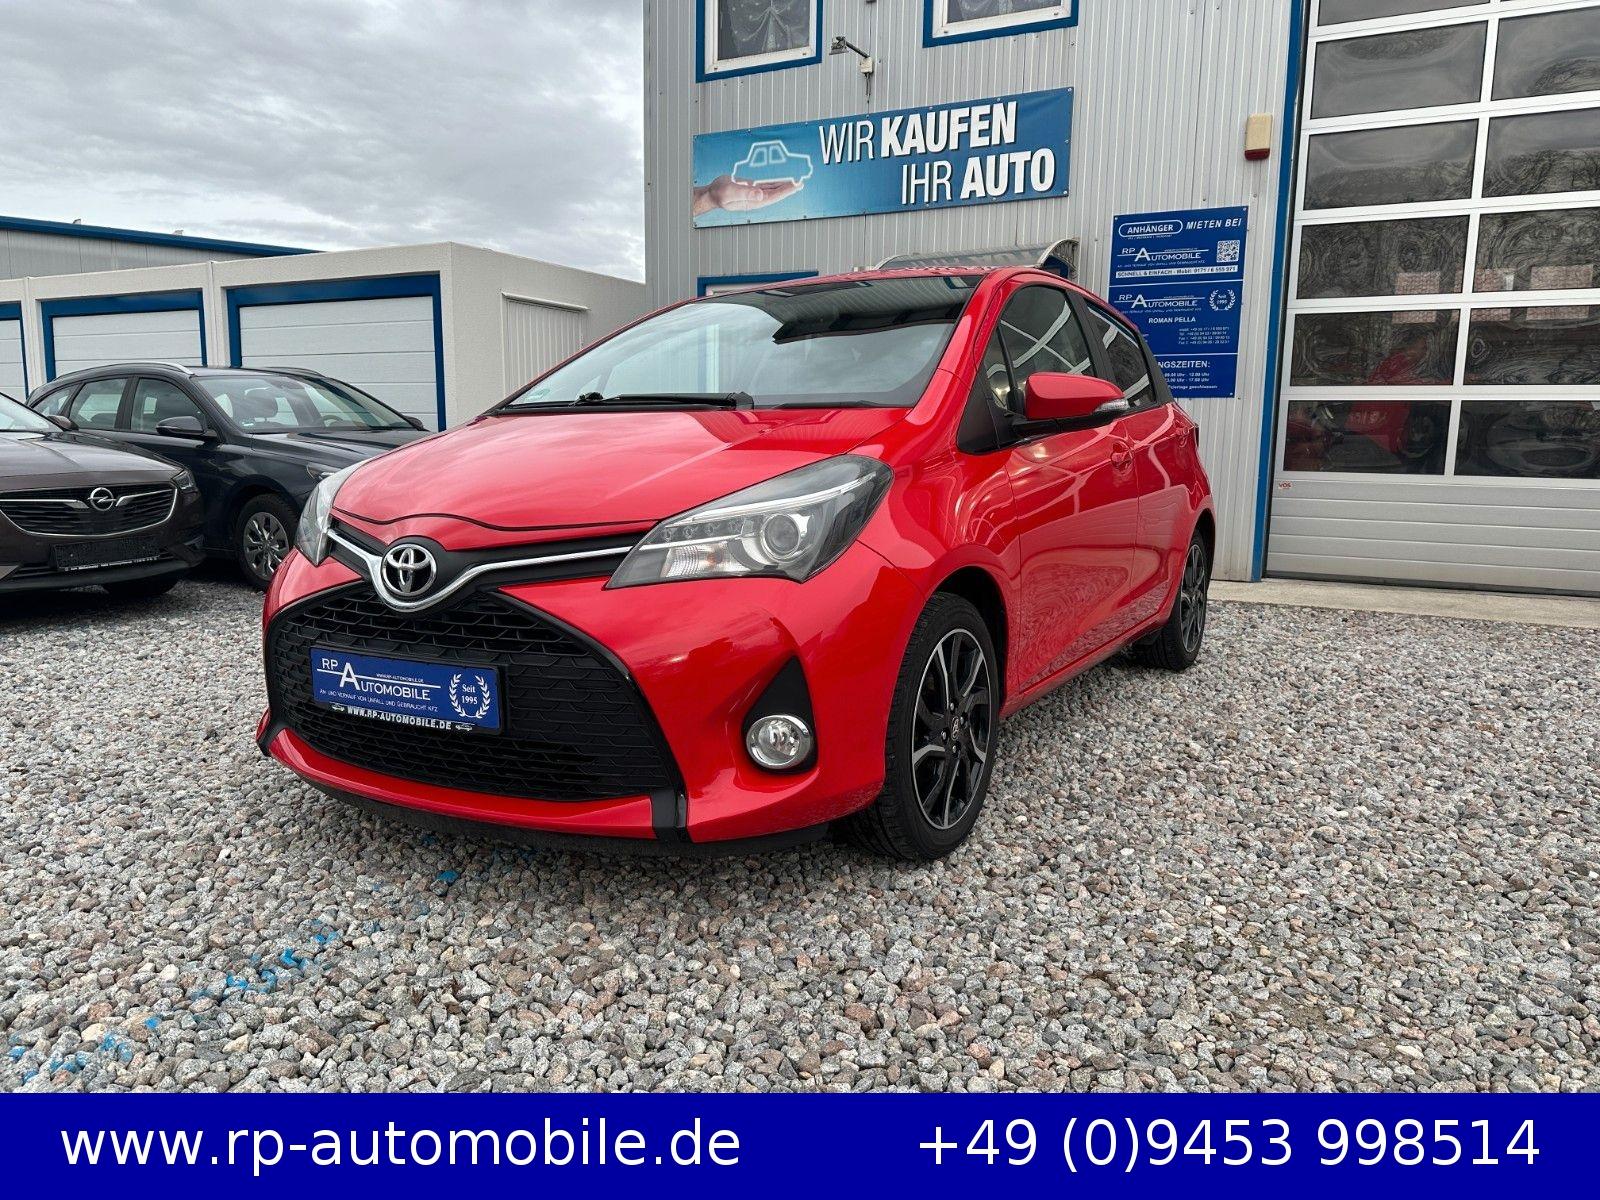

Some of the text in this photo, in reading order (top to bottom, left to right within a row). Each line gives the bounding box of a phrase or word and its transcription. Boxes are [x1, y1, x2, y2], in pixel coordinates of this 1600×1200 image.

[819, 101, 1017, 165] WIR KAUFEN
[901, 148, 1056, 205] IHR AUTO
[1127, 224, 1174, 234] ANHÄNGER
[1186, 218, 1242, 230] MIETEN BEI
[1134, 247, 1202, 262] AUTOMOBILE
[1131, 294, 1198, 309] AUTOMOBILE
[1158, 360, 1210, 368] NGSZEITEN:
[321, 658, 431, 700] RP AUTOMOBILE
[462, 684, 476, 693] Seit
[461, 695, 478, 705] 1995
[347, 705, 452, 730] WWW.RP-AUTOMOBILE.DE
